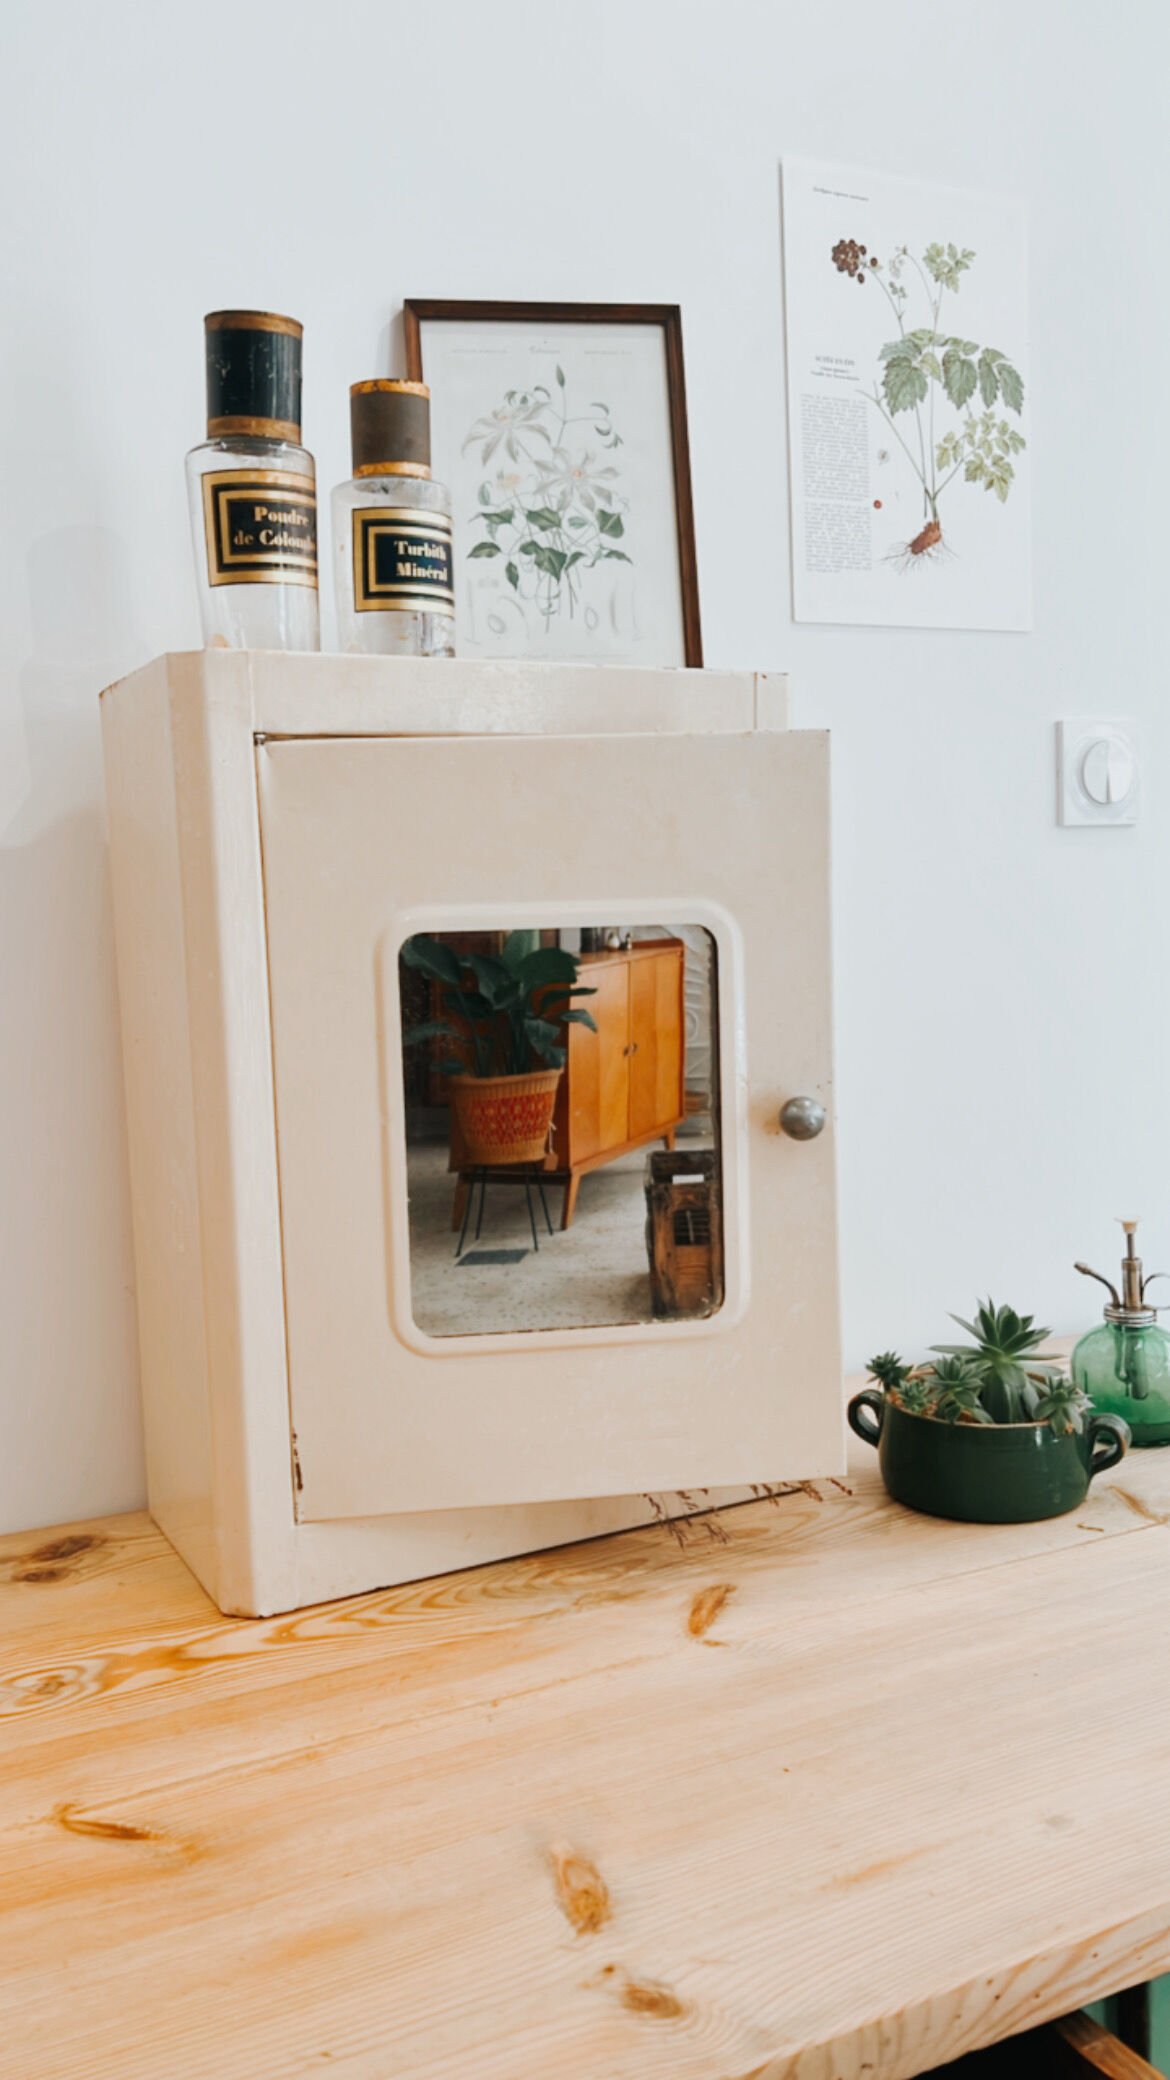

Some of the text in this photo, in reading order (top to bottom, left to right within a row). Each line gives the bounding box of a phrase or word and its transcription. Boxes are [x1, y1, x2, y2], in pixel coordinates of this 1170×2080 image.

[254, 506, 309, 527] Poudre
[233, 530, 254, 545] de
[393, 540, 447, 561] Turbith
[396, 561, 448, 582] Minéral
